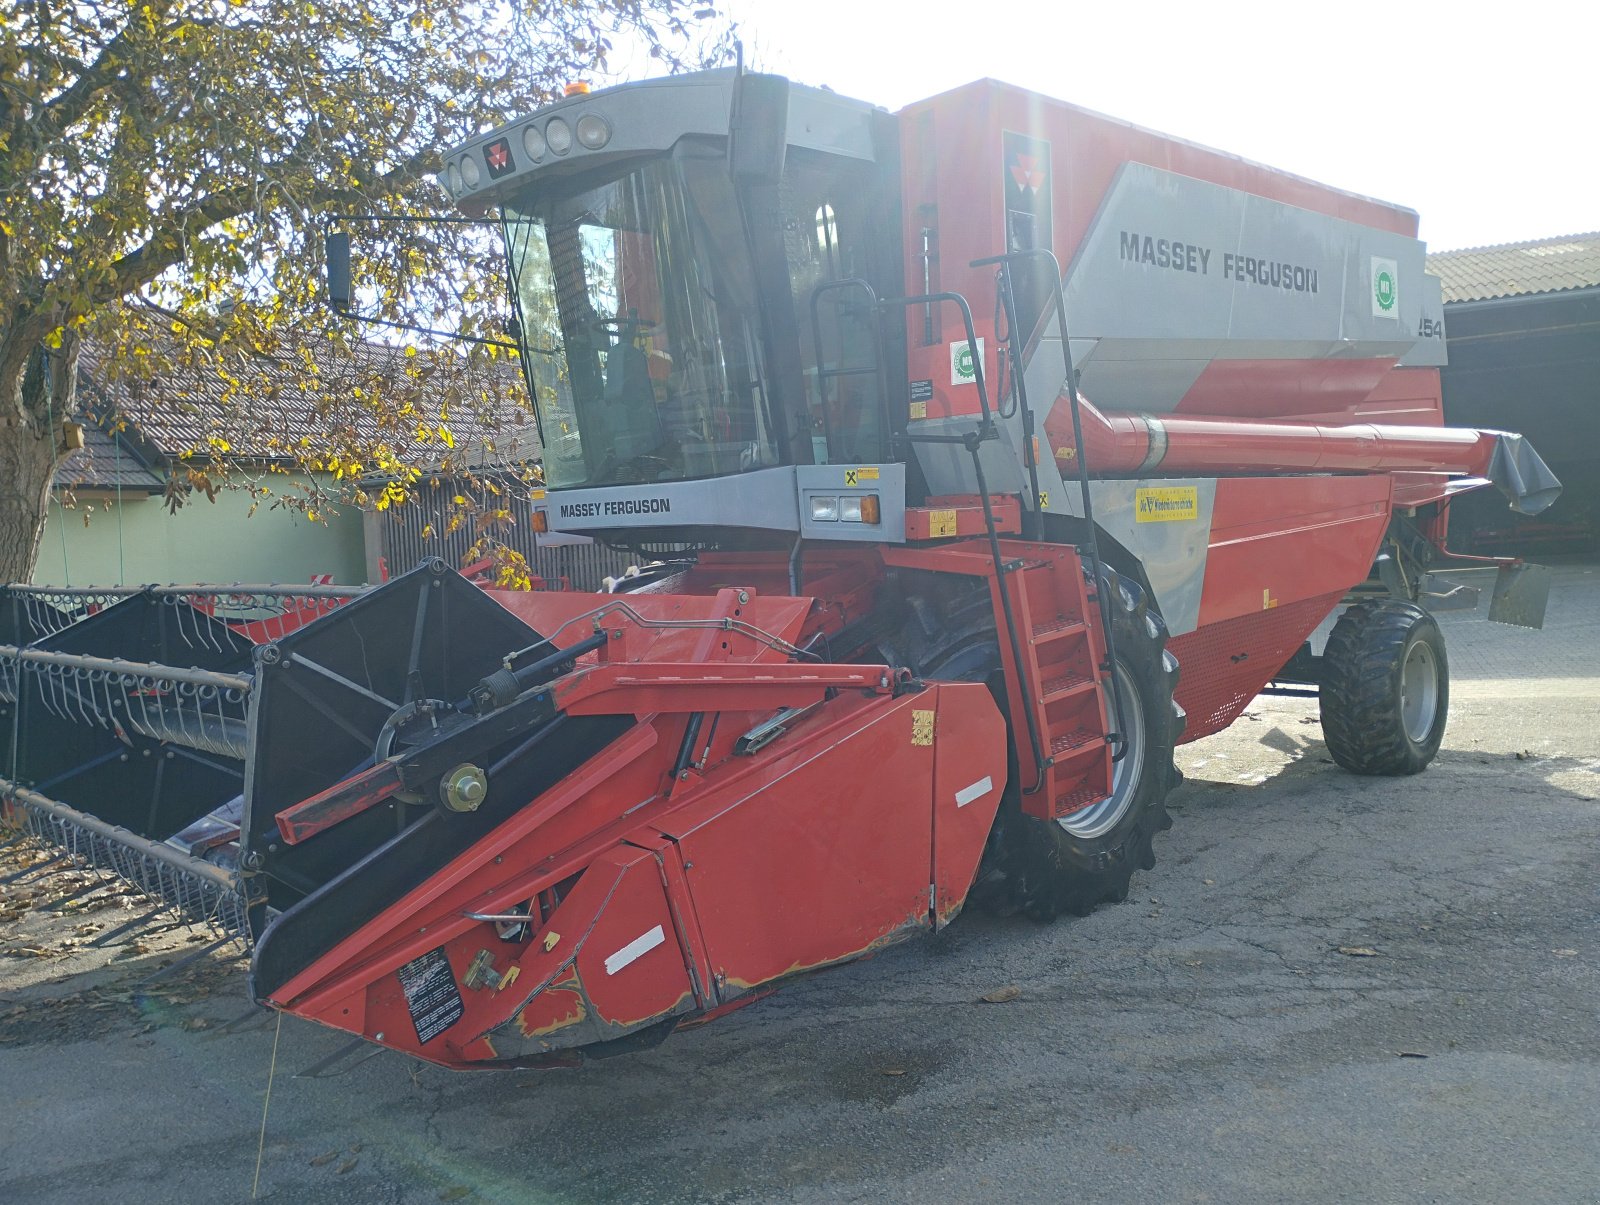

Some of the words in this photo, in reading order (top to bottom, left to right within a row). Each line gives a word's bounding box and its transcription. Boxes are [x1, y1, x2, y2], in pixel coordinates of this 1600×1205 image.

[1120, 231, 1211, 276] MASSEY
[1223, 252, 1319, 293] FERGUSON
[560, 503, 601, 518] MASSEY
[604, 498, 671, 516] FERGUSON
